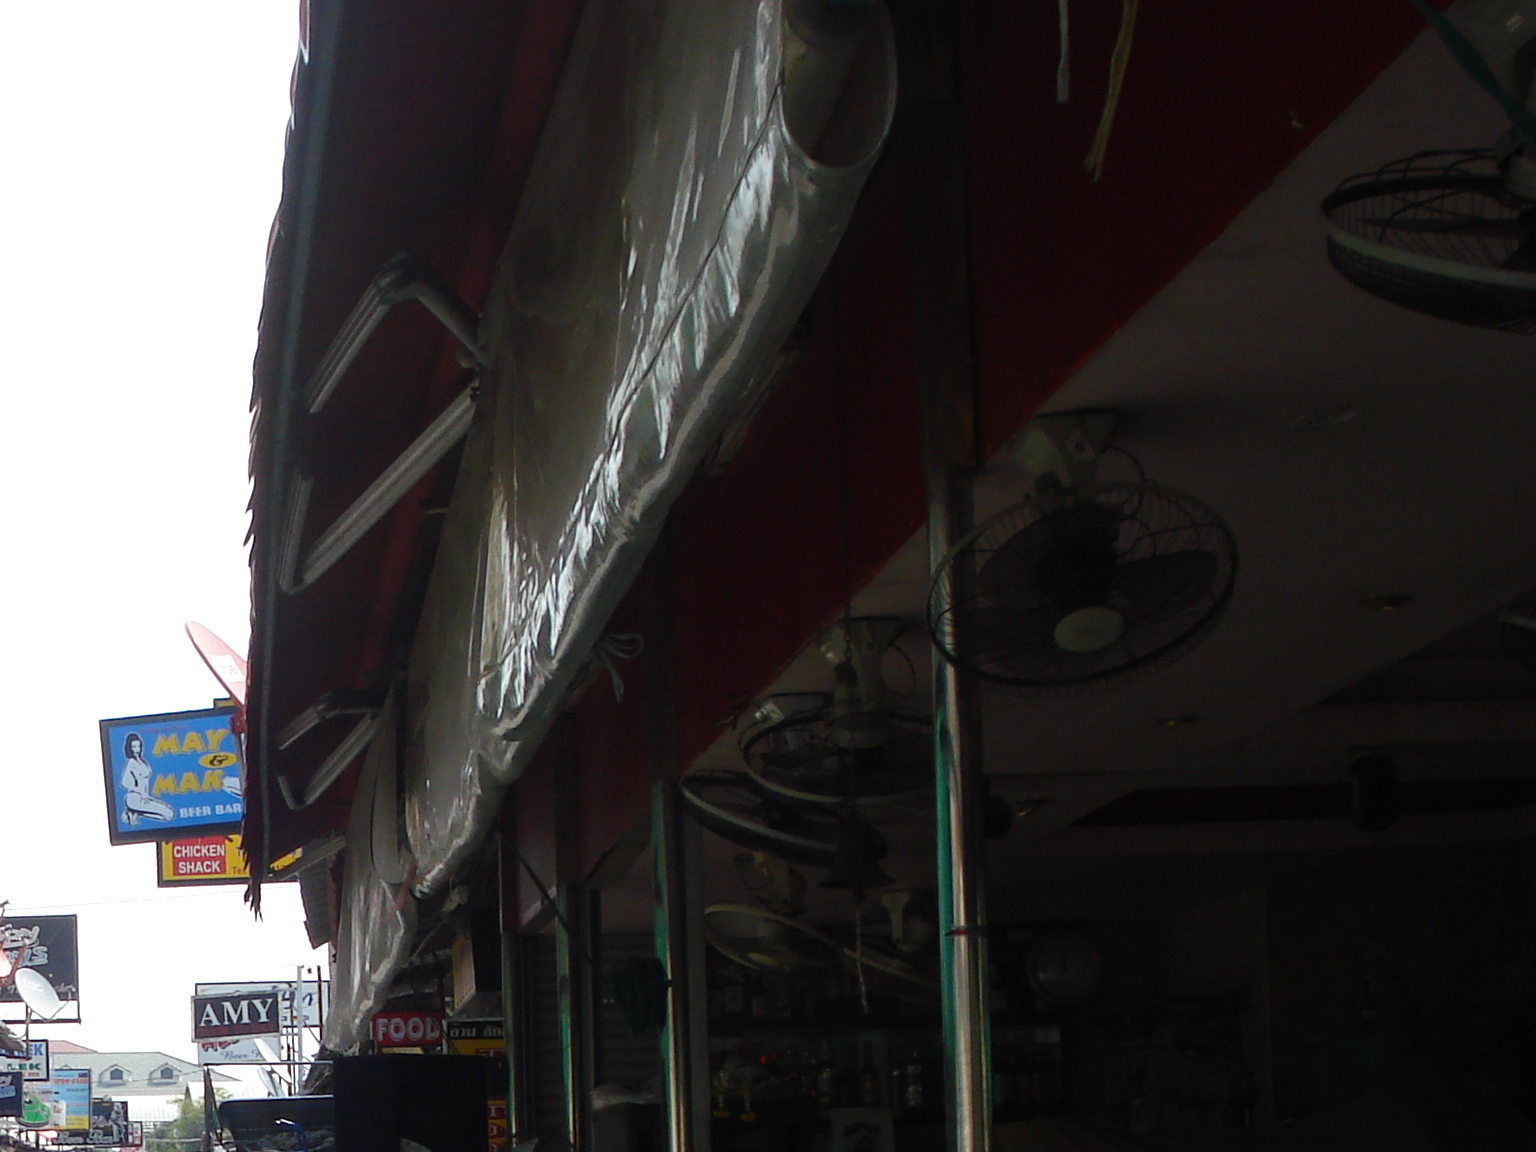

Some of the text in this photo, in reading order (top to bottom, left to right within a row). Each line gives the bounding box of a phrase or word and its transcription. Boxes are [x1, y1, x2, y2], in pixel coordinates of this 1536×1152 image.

[152, 730, 229, 755] MAY
[209, 754, 228, 766] &
[152, 769, 224, 795] MAK
[179, 803, 242, 818] BEER BAR
[174, 845, 225, 858] CHICKEN
[178, 861, 221, 873] SHACK
[199, 998, 274, 1027] AMY
[376, 1017, 440, 1042] FOOD
